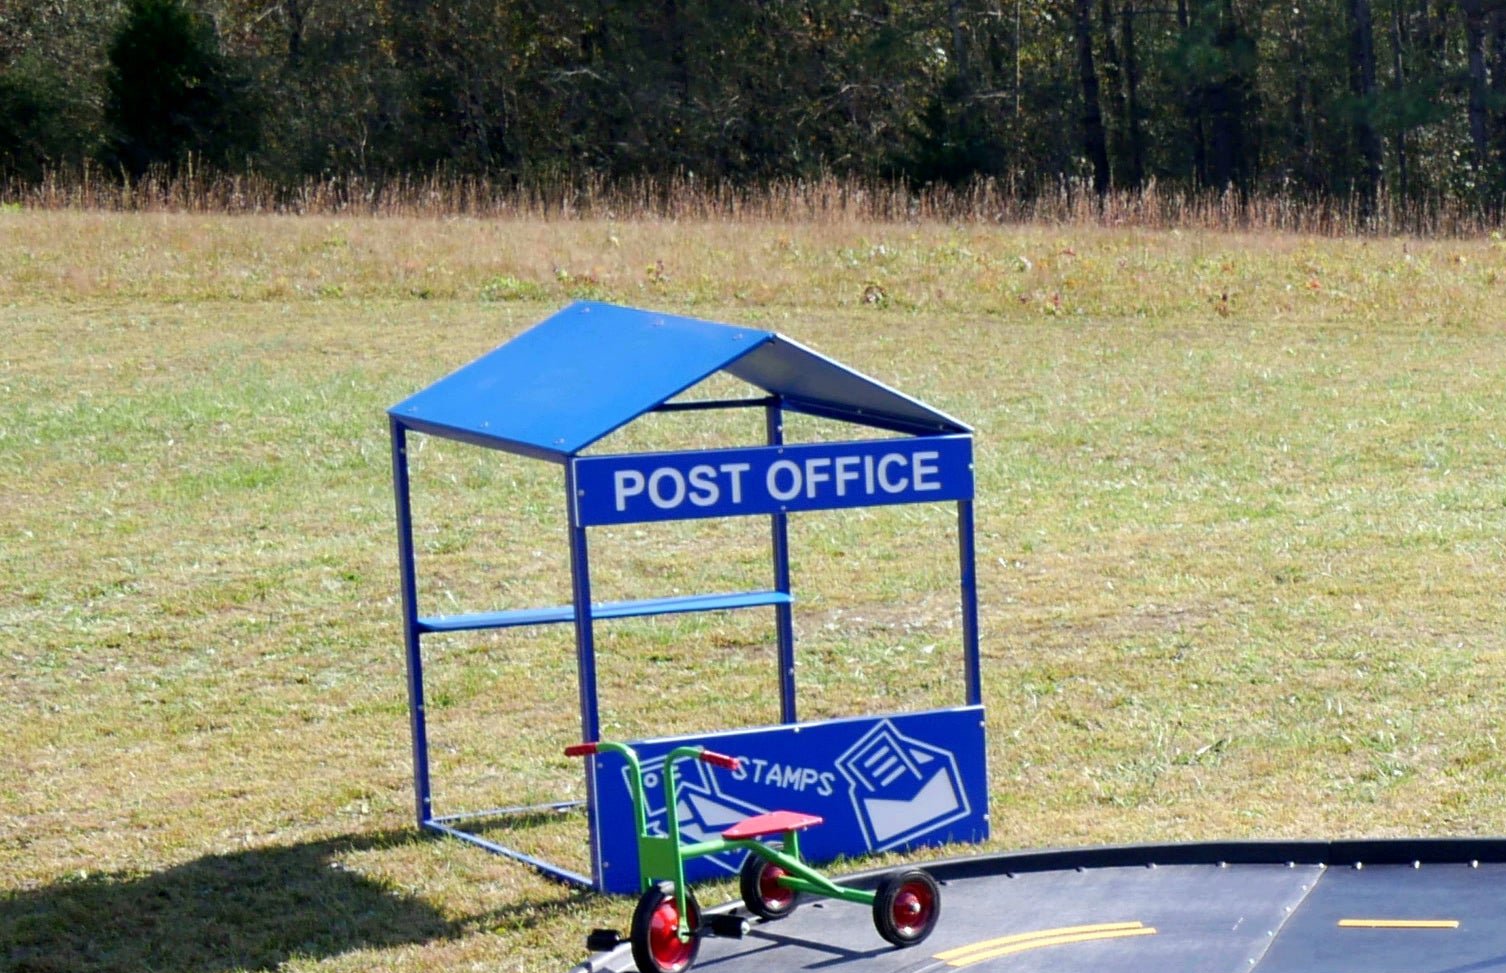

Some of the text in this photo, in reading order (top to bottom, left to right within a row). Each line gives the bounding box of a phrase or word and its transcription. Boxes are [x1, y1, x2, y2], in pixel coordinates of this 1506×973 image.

[614, 451, 941, 511] POST OFFICE
[731, 755, 836, 796] STAMPS
